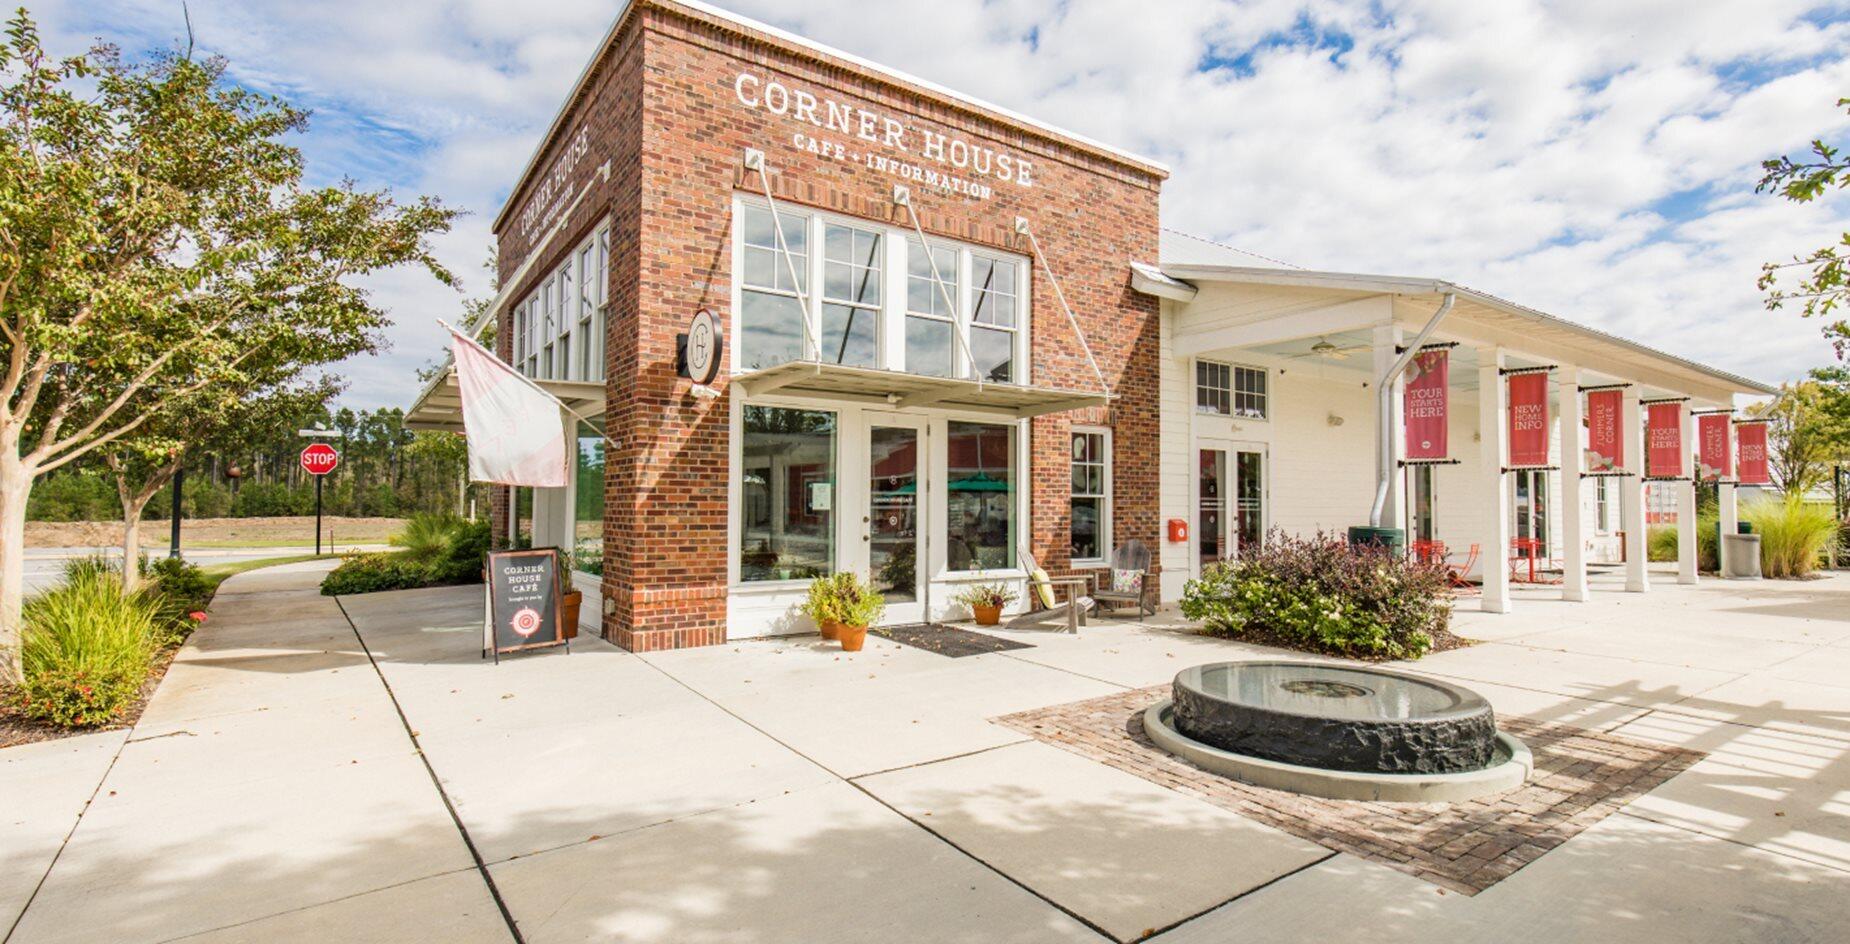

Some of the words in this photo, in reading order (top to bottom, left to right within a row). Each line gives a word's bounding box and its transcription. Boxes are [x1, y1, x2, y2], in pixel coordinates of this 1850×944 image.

[734, 73, 908, 151] CORNER
[922, 129, 1033, 188] HOUSE
[554, 124, 588, 193] HOUSE
[793, 133, 846, 161] CAFE
[866, 153, 992, 200] INFORMATION
[1410, 388, 1444, 400] TOUR
[1410, 399, 1444, 408] STARTS
[1410, 406, 1444, 418] HERE
[1514, 404, 1543, 414] NEW
[1514, 413, 1543, 422] HOME
[1514, 421, 1543, 431] INFO
[1605, 405, 1615, 444] CORNER
[1651, 428, 1678, 436] TOUR
[1651, 440, 1680, 449] HERE
[303, 453, 335, 465] STOP
[503, 565, 544, 575] CORNER
[508, 574, 541, 584] HOUSE
